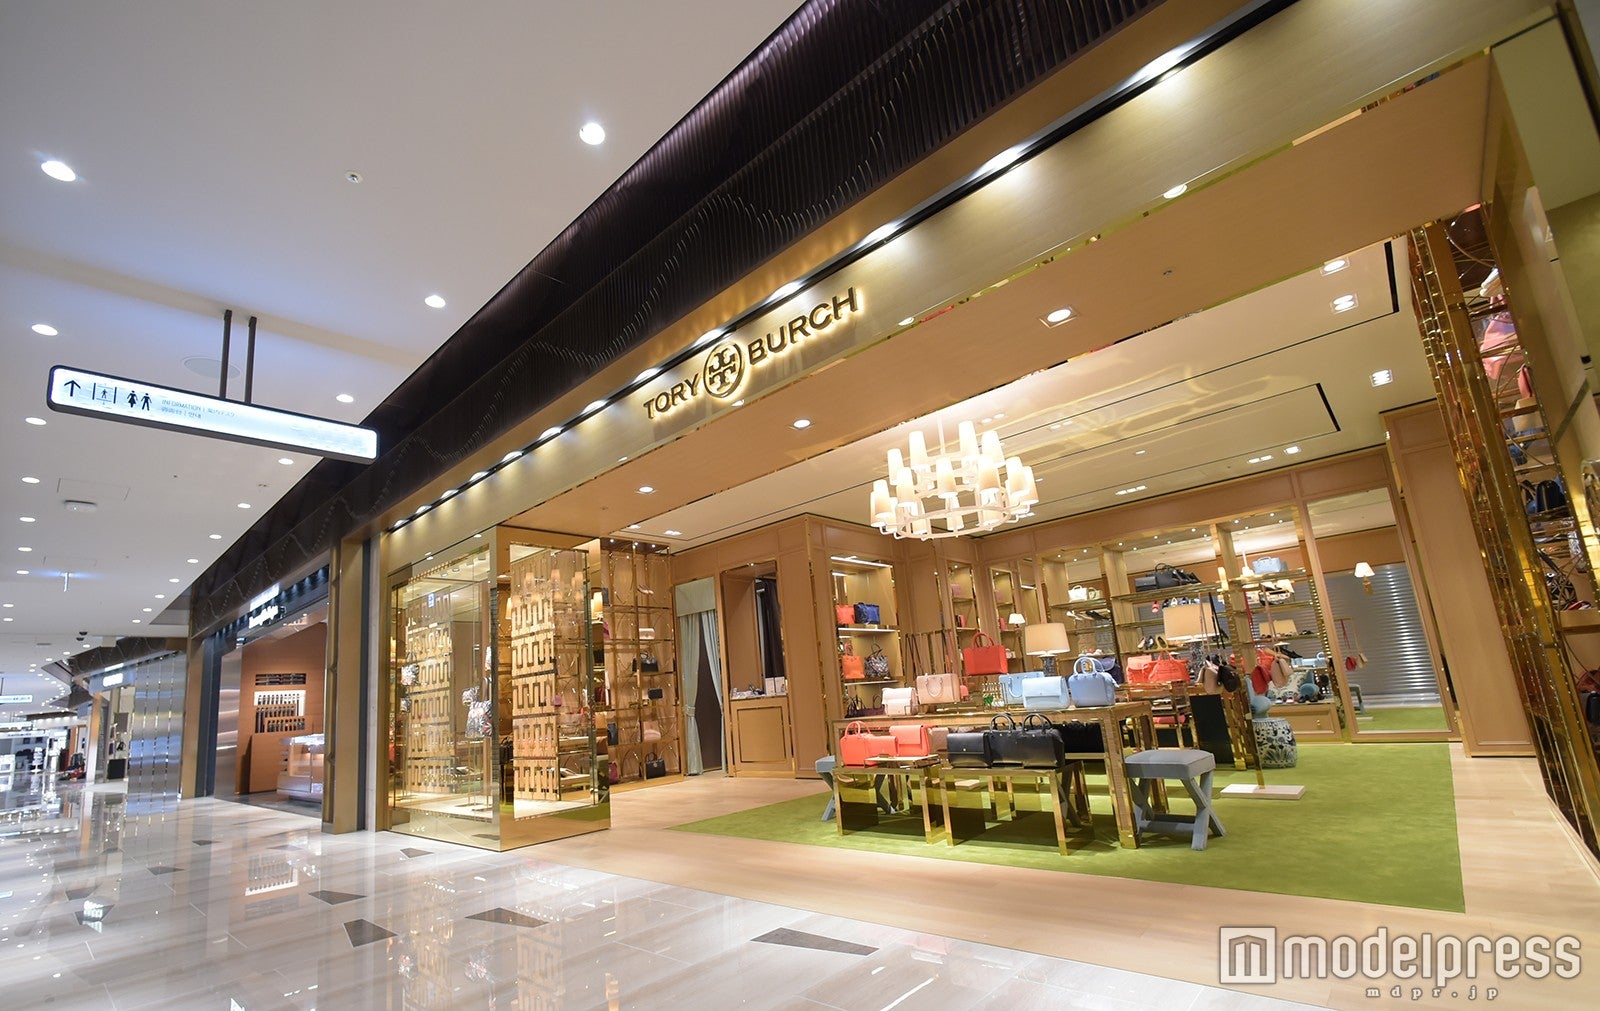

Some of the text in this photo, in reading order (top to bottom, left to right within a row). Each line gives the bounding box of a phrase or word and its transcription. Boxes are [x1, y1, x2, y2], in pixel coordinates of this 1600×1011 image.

[643, 373, 701, 420] TORY
[747, 286, 859, 366] BURCH
[161, 399, 201, 411] INFORMATION
